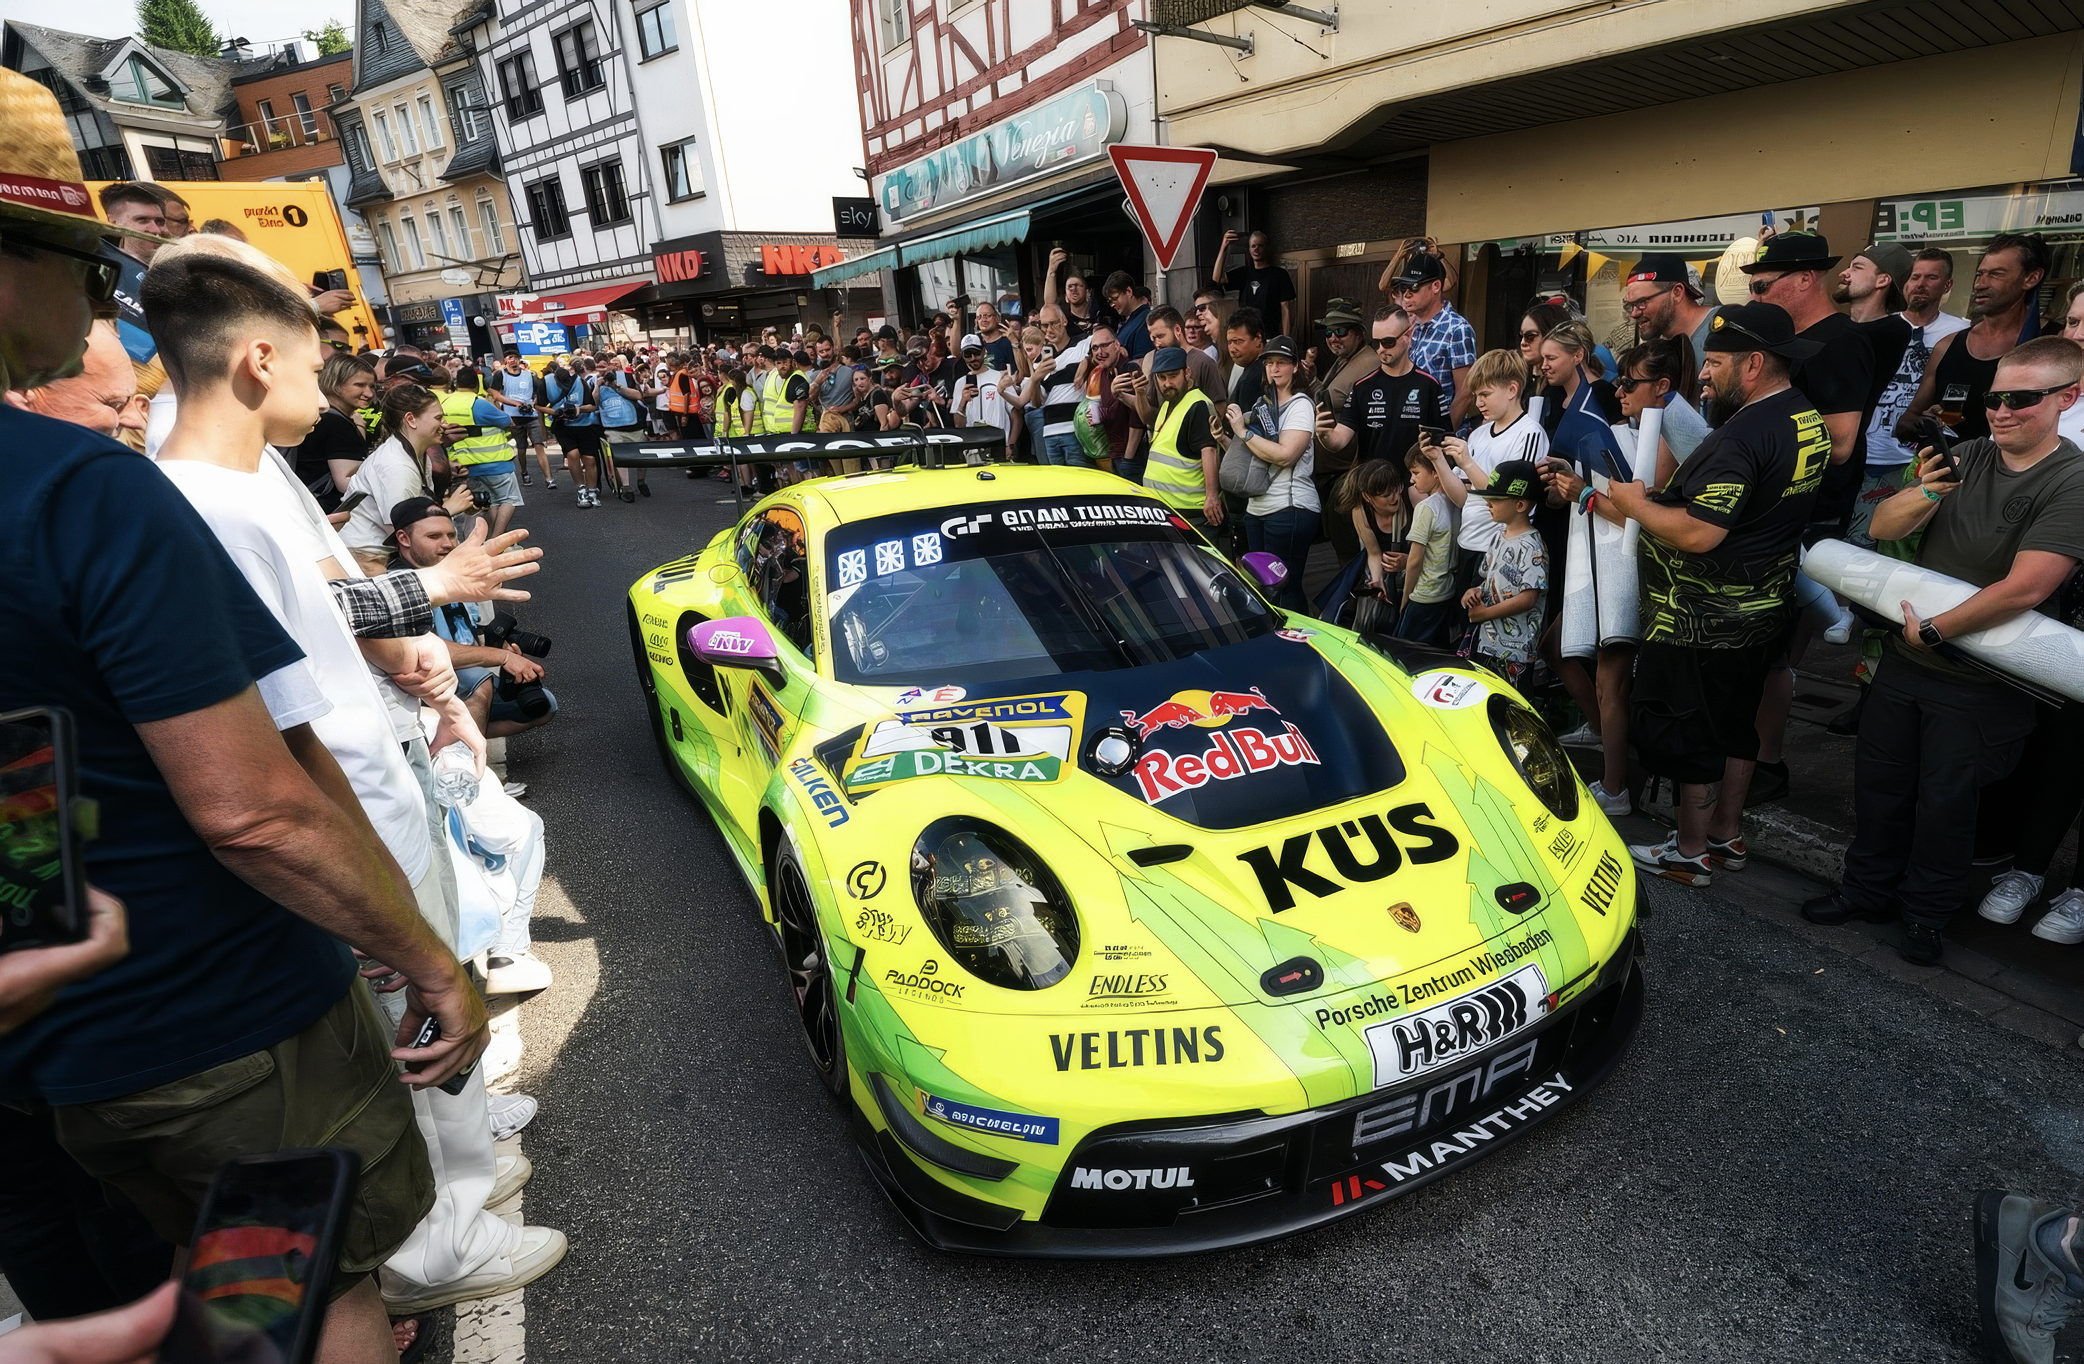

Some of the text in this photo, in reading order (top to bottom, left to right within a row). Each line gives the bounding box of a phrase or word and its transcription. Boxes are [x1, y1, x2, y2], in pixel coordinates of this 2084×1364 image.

[841, 207, 872, 228] sky
[656, 250, 701, 283] NKD
[1002, 505, 1167, 526] GRAN TURISMO
[914, 751, 1048, 781] DEKRA
[1134, 721, 1320, 801] Red Bull
[1236, 802, 1459, 914] KÜS
[885, 969, 966, 999] PADDOCK
[1089, 974, 1169, 995] ENDLESS
[1315, 928, 1552, 1030] Porsche Zentrum Wiesbaden
[1049, 1026, 1225, 1072] VELTINS
[1380, 1071, 1573, 1182] MANTHEY
[1071, 1166, 1194, 1191] MOTUL
